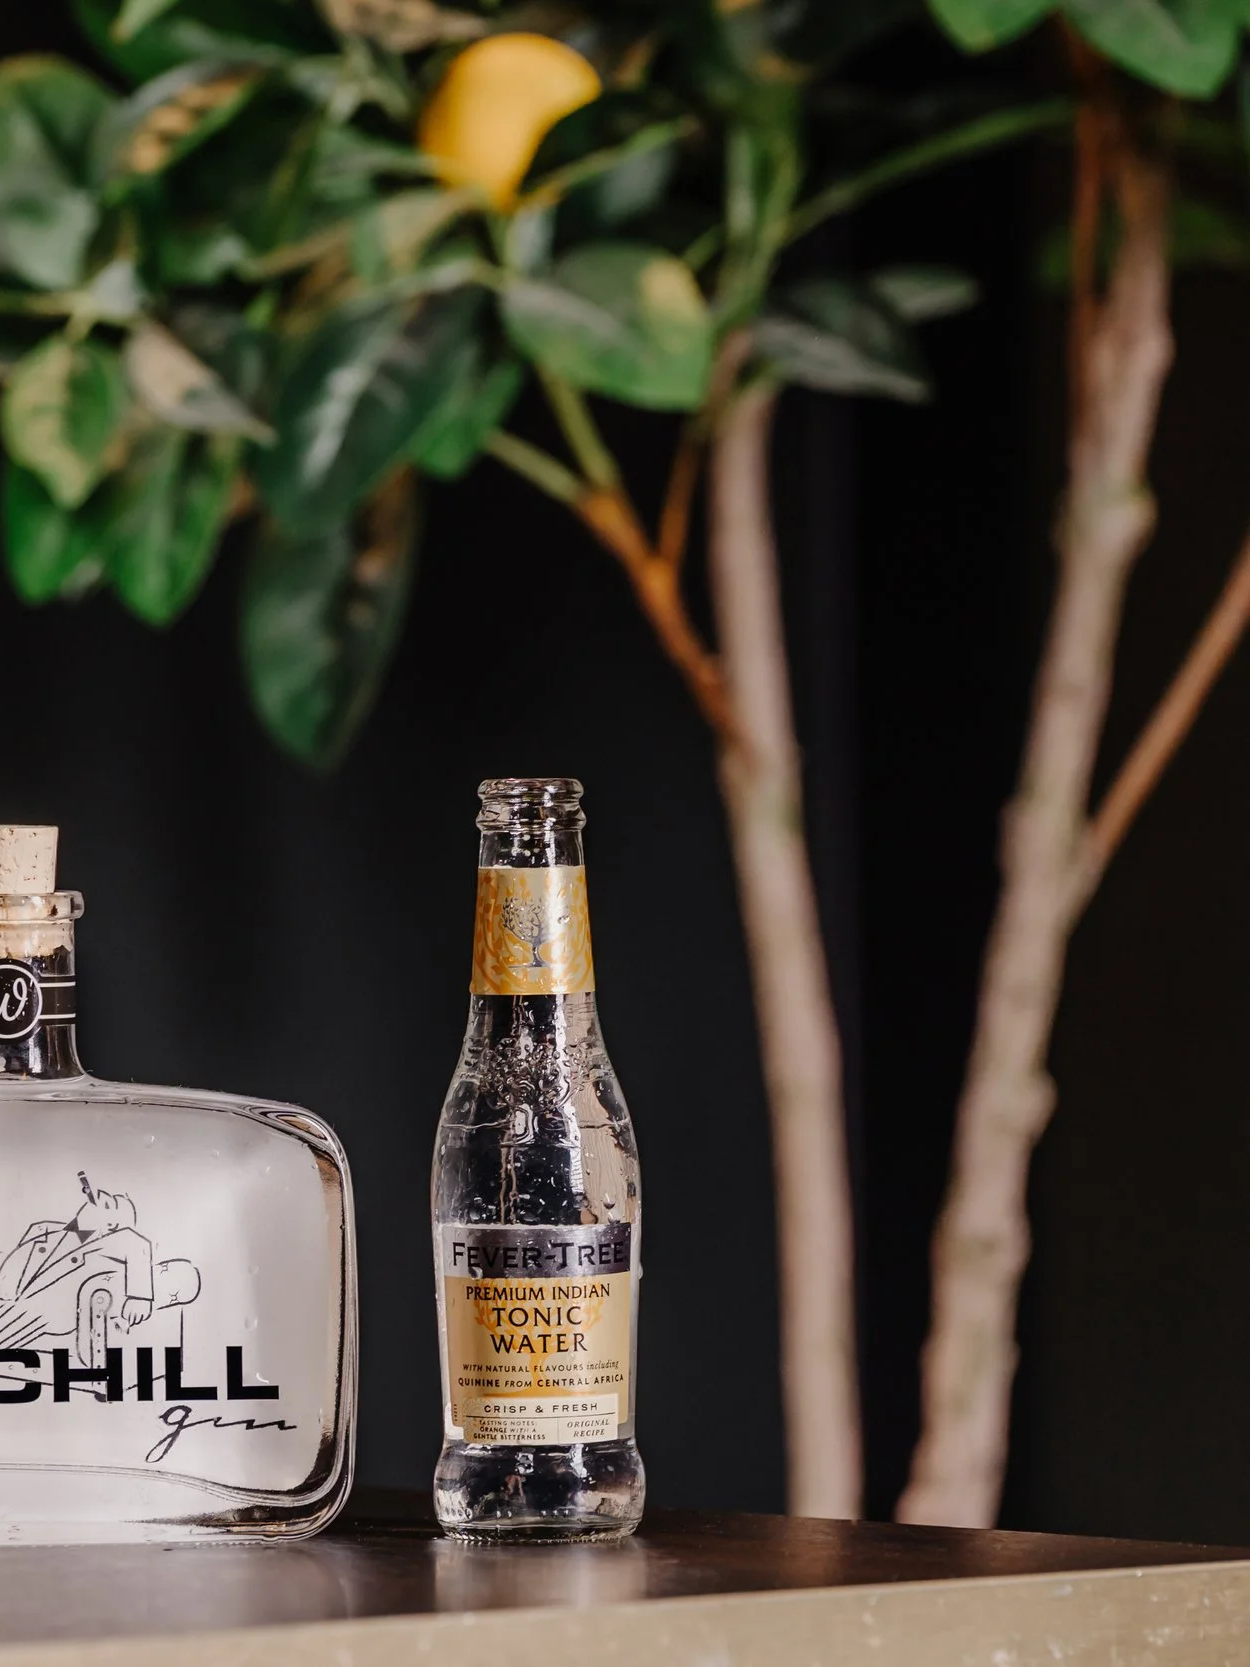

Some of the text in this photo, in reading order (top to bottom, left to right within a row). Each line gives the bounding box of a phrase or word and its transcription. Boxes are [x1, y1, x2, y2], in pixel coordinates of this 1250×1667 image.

[452, 1240, 625, 1270] FEVER-TREE
[466, 1283, 610, 1301] PREMIUM INDIAN
[491, 1306, 582, 1327] TONIC
[490, 1333, 588, 1354] WATER
[462, 1360, 620, 1373] WITH NATURAL FLAVOURS including
[458, 1373, 624, 1388] QUININE FROM CENTRAL AFRICA
[483, 1403, 598, 1414] CRISP & FRESH
[566, 1418, 610, 1428] ORIGINAL
[479, 1426, 508, 1434] ORANGE
[573, 1429, 605, 1438] RECIPE
[473, 1433, 546, 1441] GENTLE BITTERNESS
